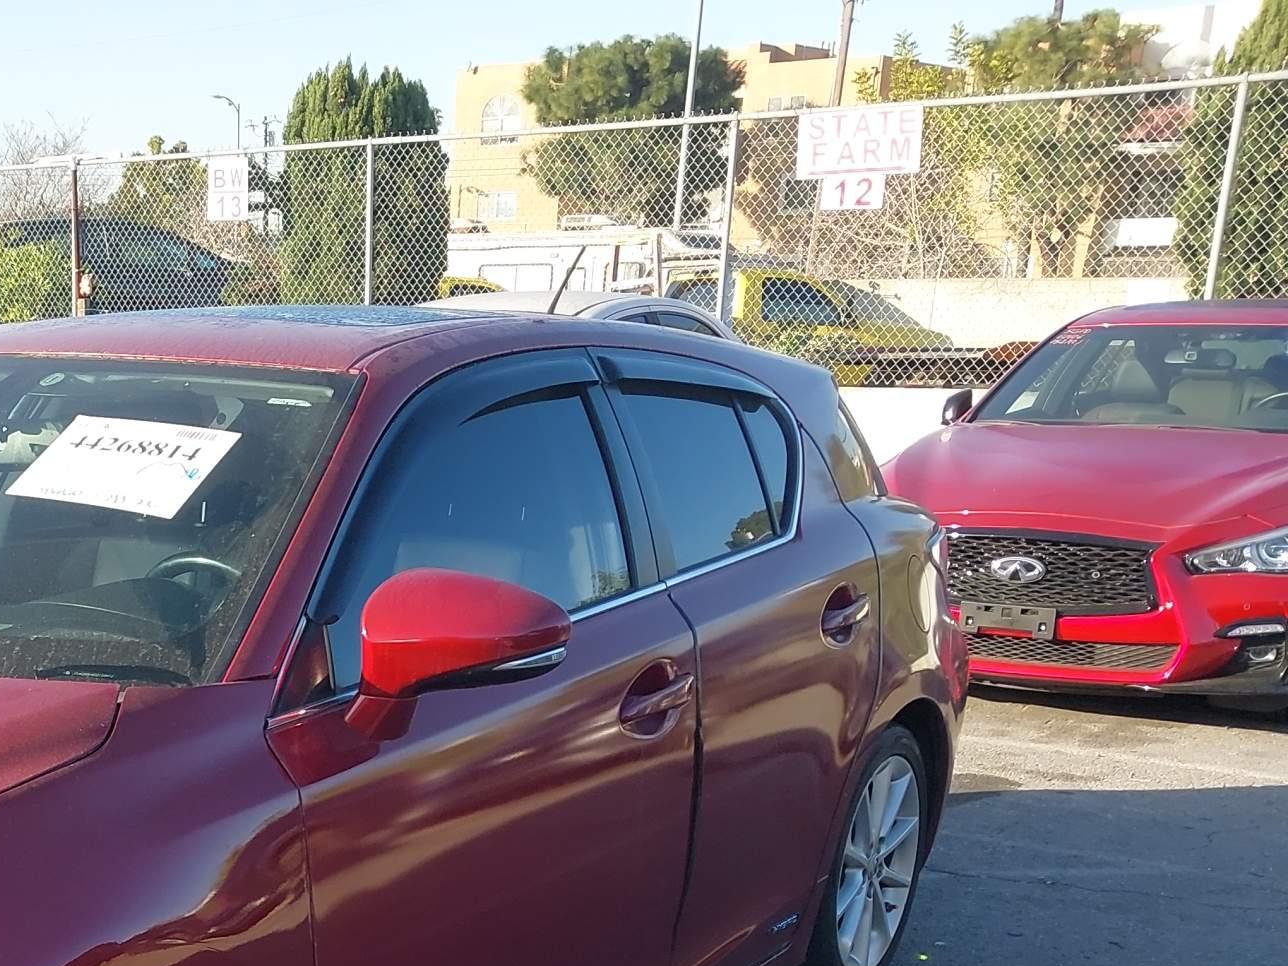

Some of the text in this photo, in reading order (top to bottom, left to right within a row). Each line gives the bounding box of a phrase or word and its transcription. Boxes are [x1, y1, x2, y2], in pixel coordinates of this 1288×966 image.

[808, 109, 917, 140] STATE
[812, 137, 911, 166] FARM
[217, 195, 242, 217] 13
[835, 177, 873, 207] 12
[69, 435, 202, 462] 44268814
